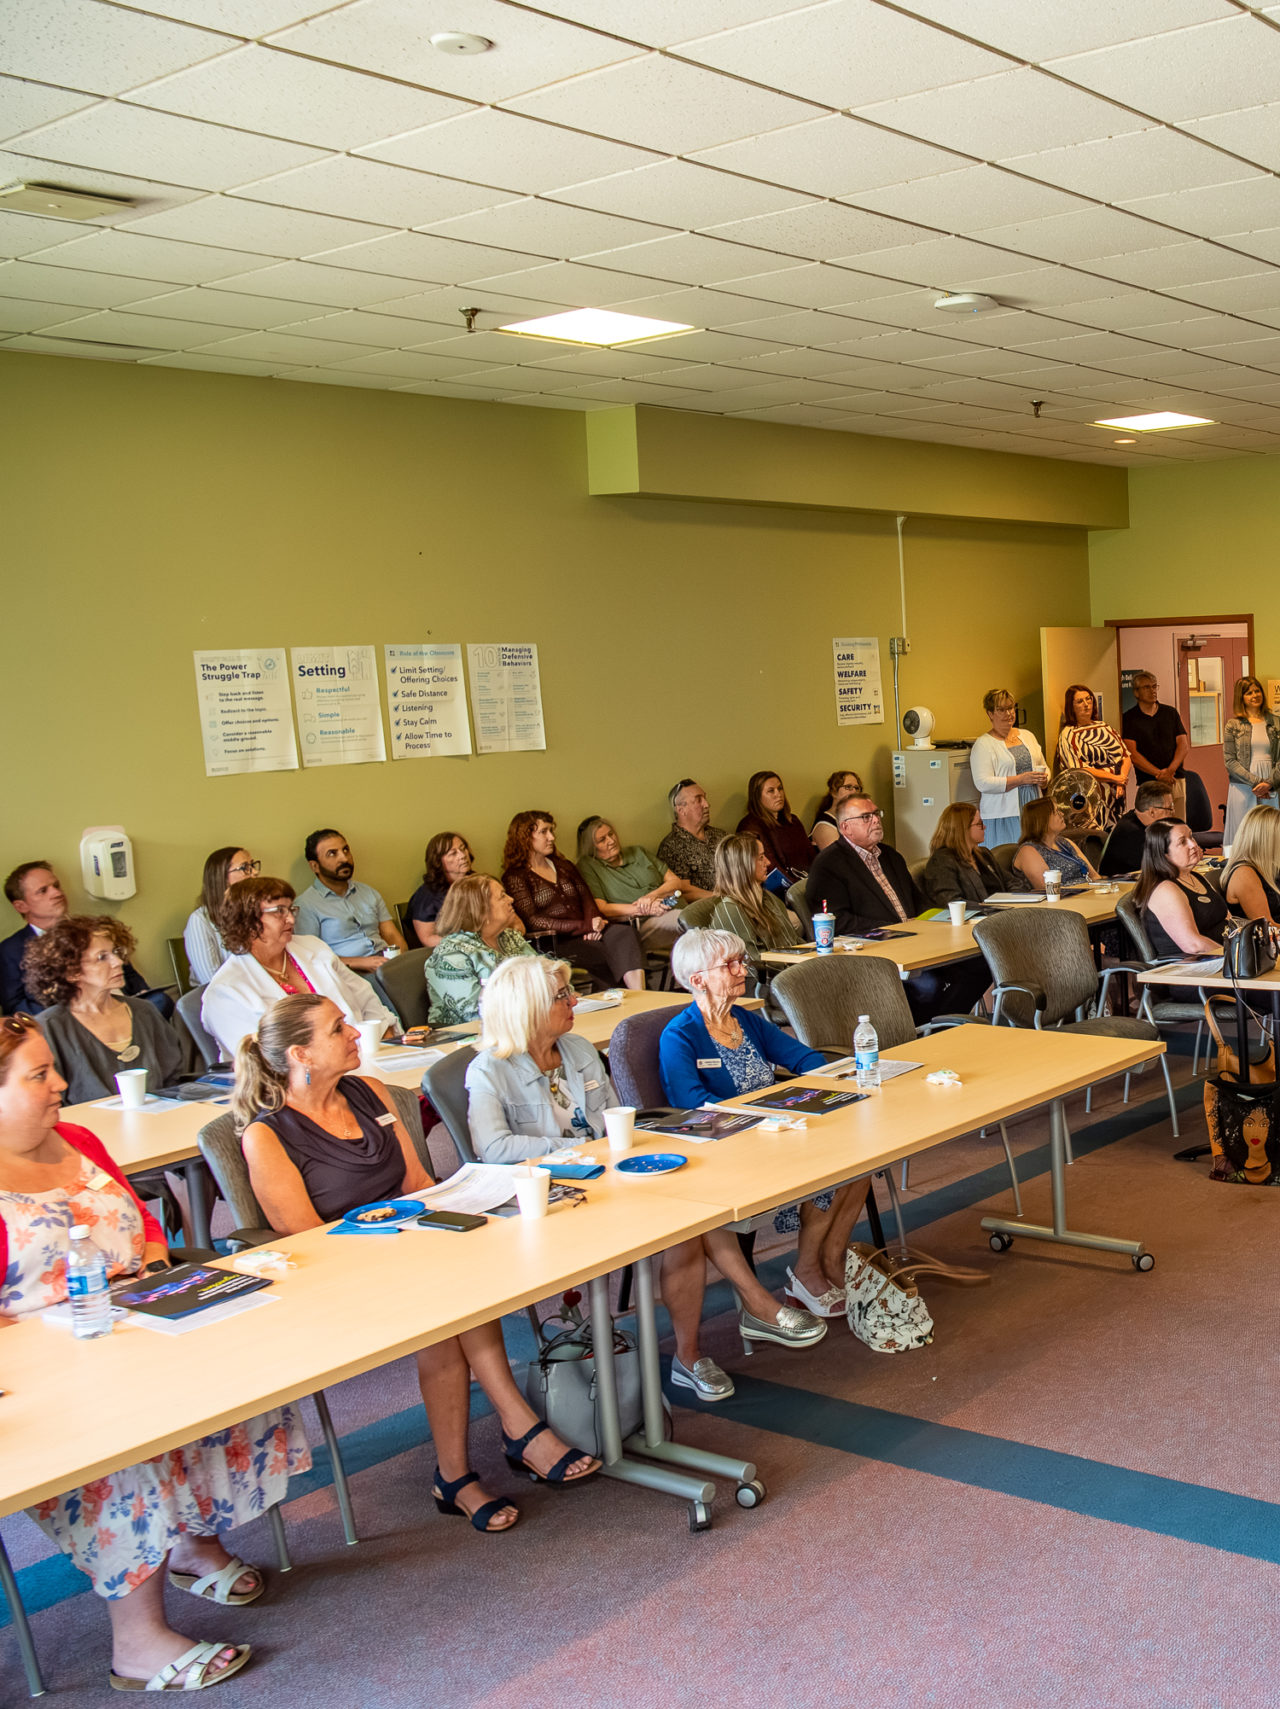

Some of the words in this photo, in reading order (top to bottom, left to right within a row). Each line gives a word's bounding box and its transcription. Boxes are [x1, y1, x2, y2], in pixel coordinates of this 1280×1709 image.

[837, 653, 854, 661] CARE
[219, 663, 247, 671] Power
[298, 664, 346, 679] Setting
[837, 670, 867, 678] WELFARE
[202, 672, 240, 682] Struggle
[241, 671, 261, 680] Trap
[400, 676, 430, 684] Offering
[431, 675, 458, 683] Choices
[316, 686, 350, 694] Respectful
[401, 690, 417, 698] Safe
[838, 687, 863, 695] SAFETY
[402, 704, 433, 712] Listening
[840, 703, 872, 712] SECURITY
[403, 718, 418, 727] Stay
[419, 717, 437, 725] Calm
[404, 732, 424, 740] Allow
[425, 731, 443, 739] Time
[405, 742, 431, 750] Process
